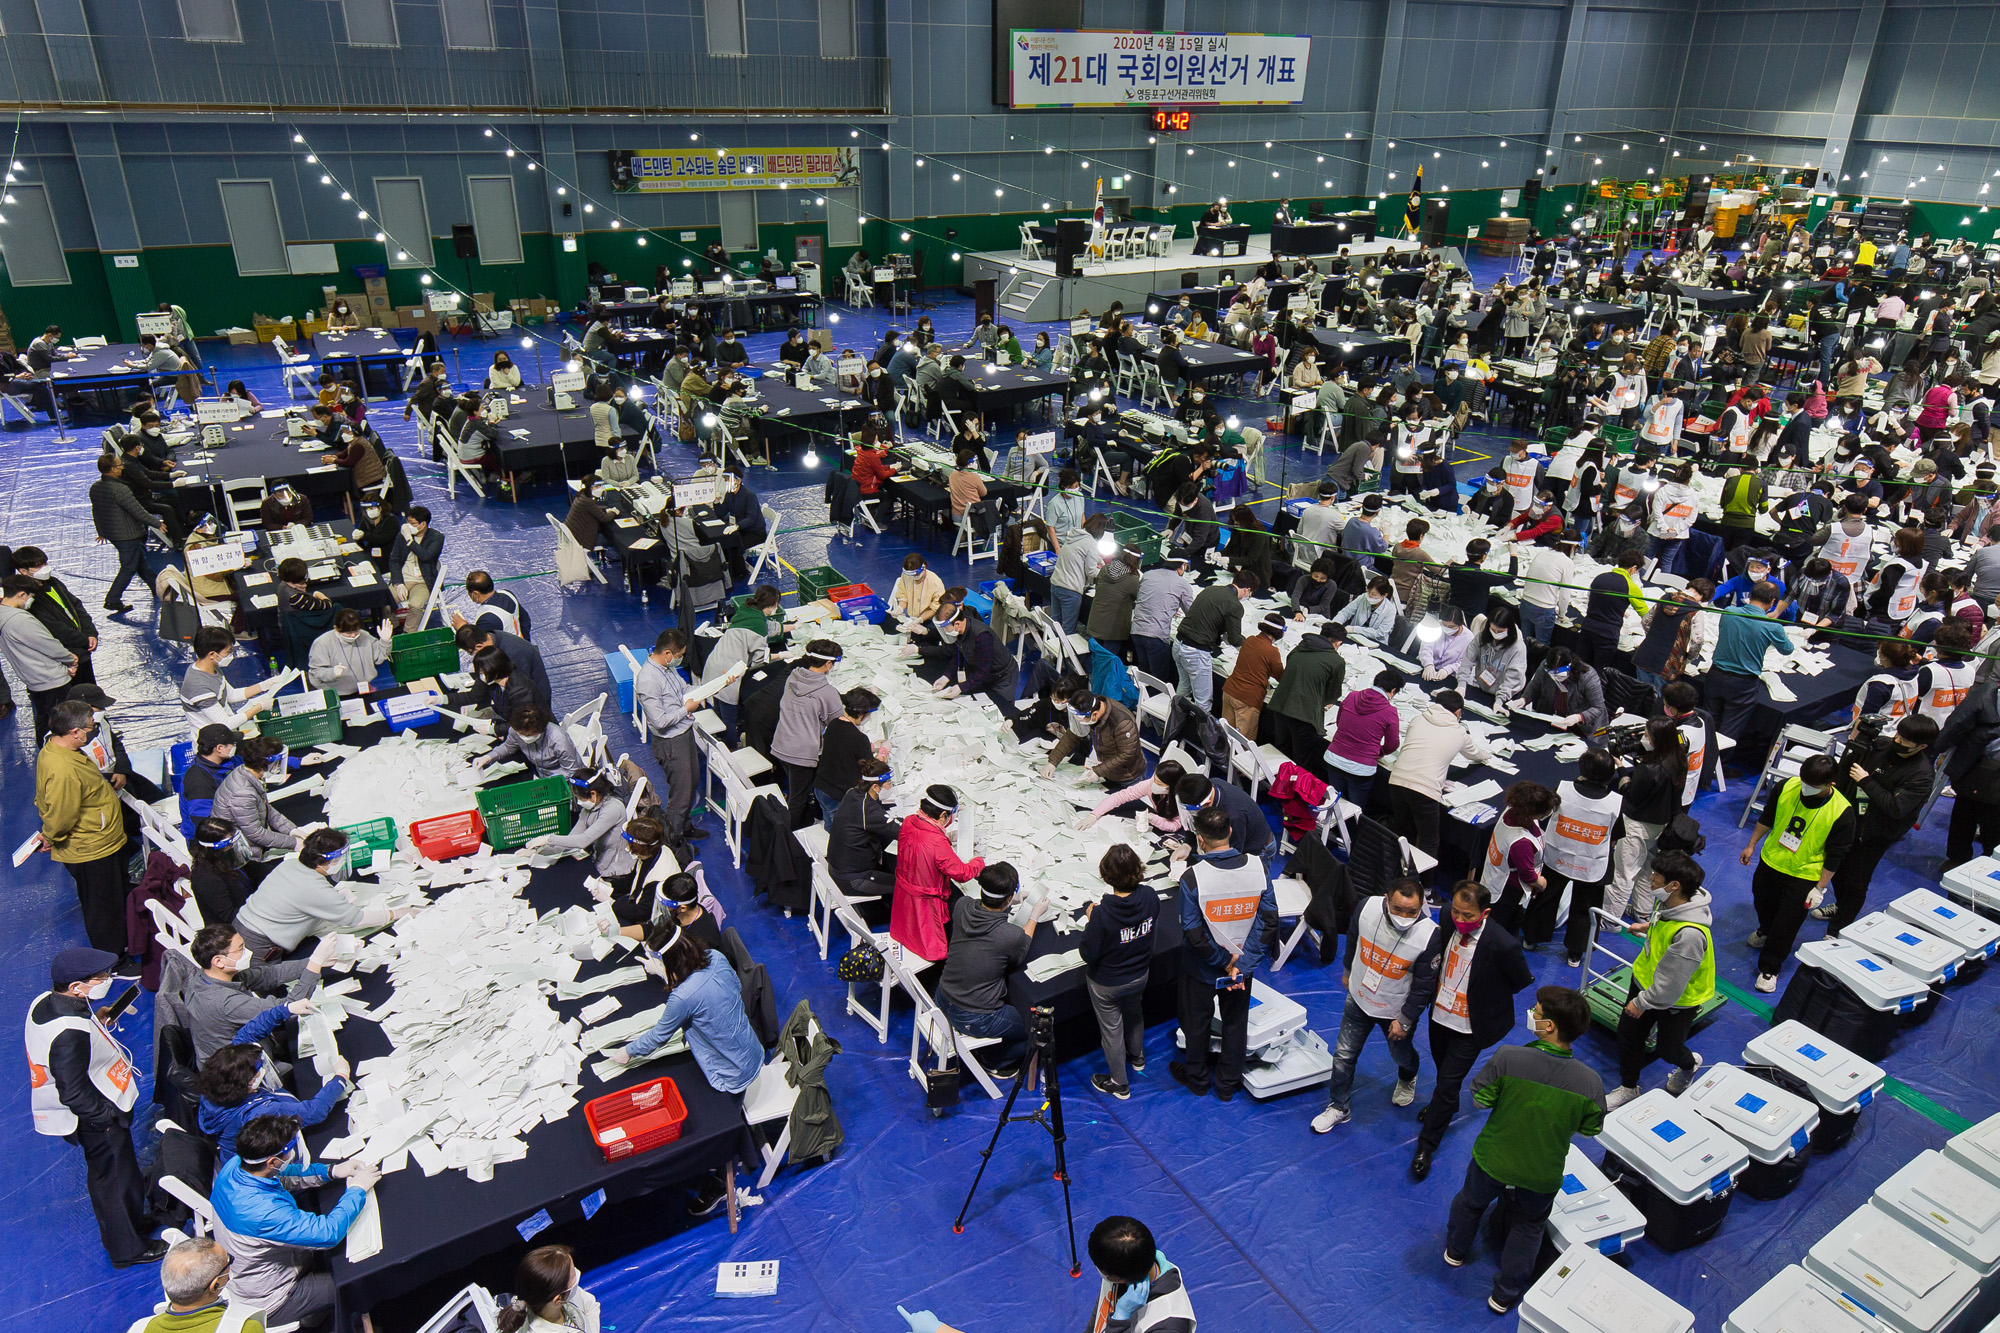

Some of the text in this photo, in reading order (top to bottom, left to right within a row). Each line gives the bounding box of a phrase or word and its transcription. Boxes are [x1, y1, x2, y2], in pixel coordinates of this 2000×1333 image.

[1113, 36, 1228, 52] 2020년 4월 15일 실시
[1028, 52, 1296, 86] 제21대 국회의원선거 개표
[1136, 88, 1217, 101] 영등포구선거관리위원회
[631, 157, 673, 177] 배드민턴
[675, 156, 715, 176] 고수되는
[717, 156, 737, 176] 숨은
[767, 154, 804, 174] 배드민턴
[805, 154, 841, 174] 필라테스
[191, 550, 241, 565] 개함·점검부
[1560, 821, 1602, 840] 개표참관
[1211, 902, 1255, 917] 개표참관
[1362, 945, 1404, 975] 개표참관
